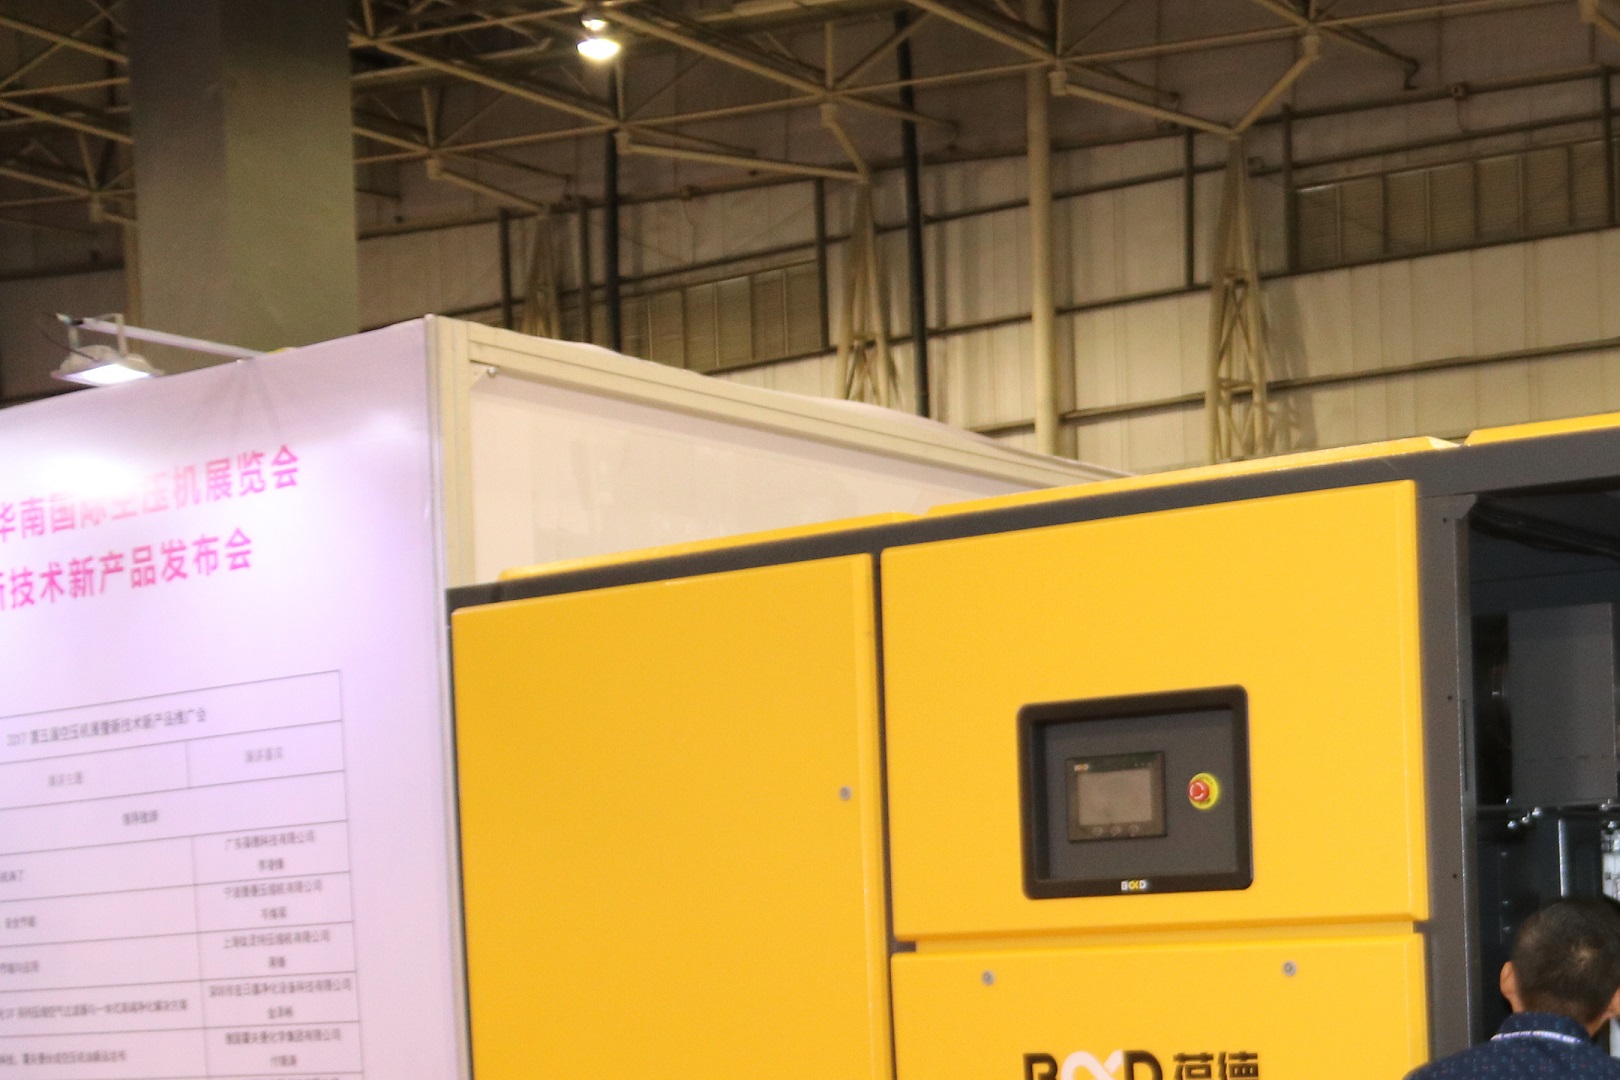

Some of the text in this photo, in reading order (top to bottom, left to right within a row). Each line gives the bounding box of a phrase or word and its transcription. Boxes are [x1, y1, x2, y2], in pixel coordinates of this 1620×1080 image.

[0, 528, 252, 610] 技术新产品发布会
